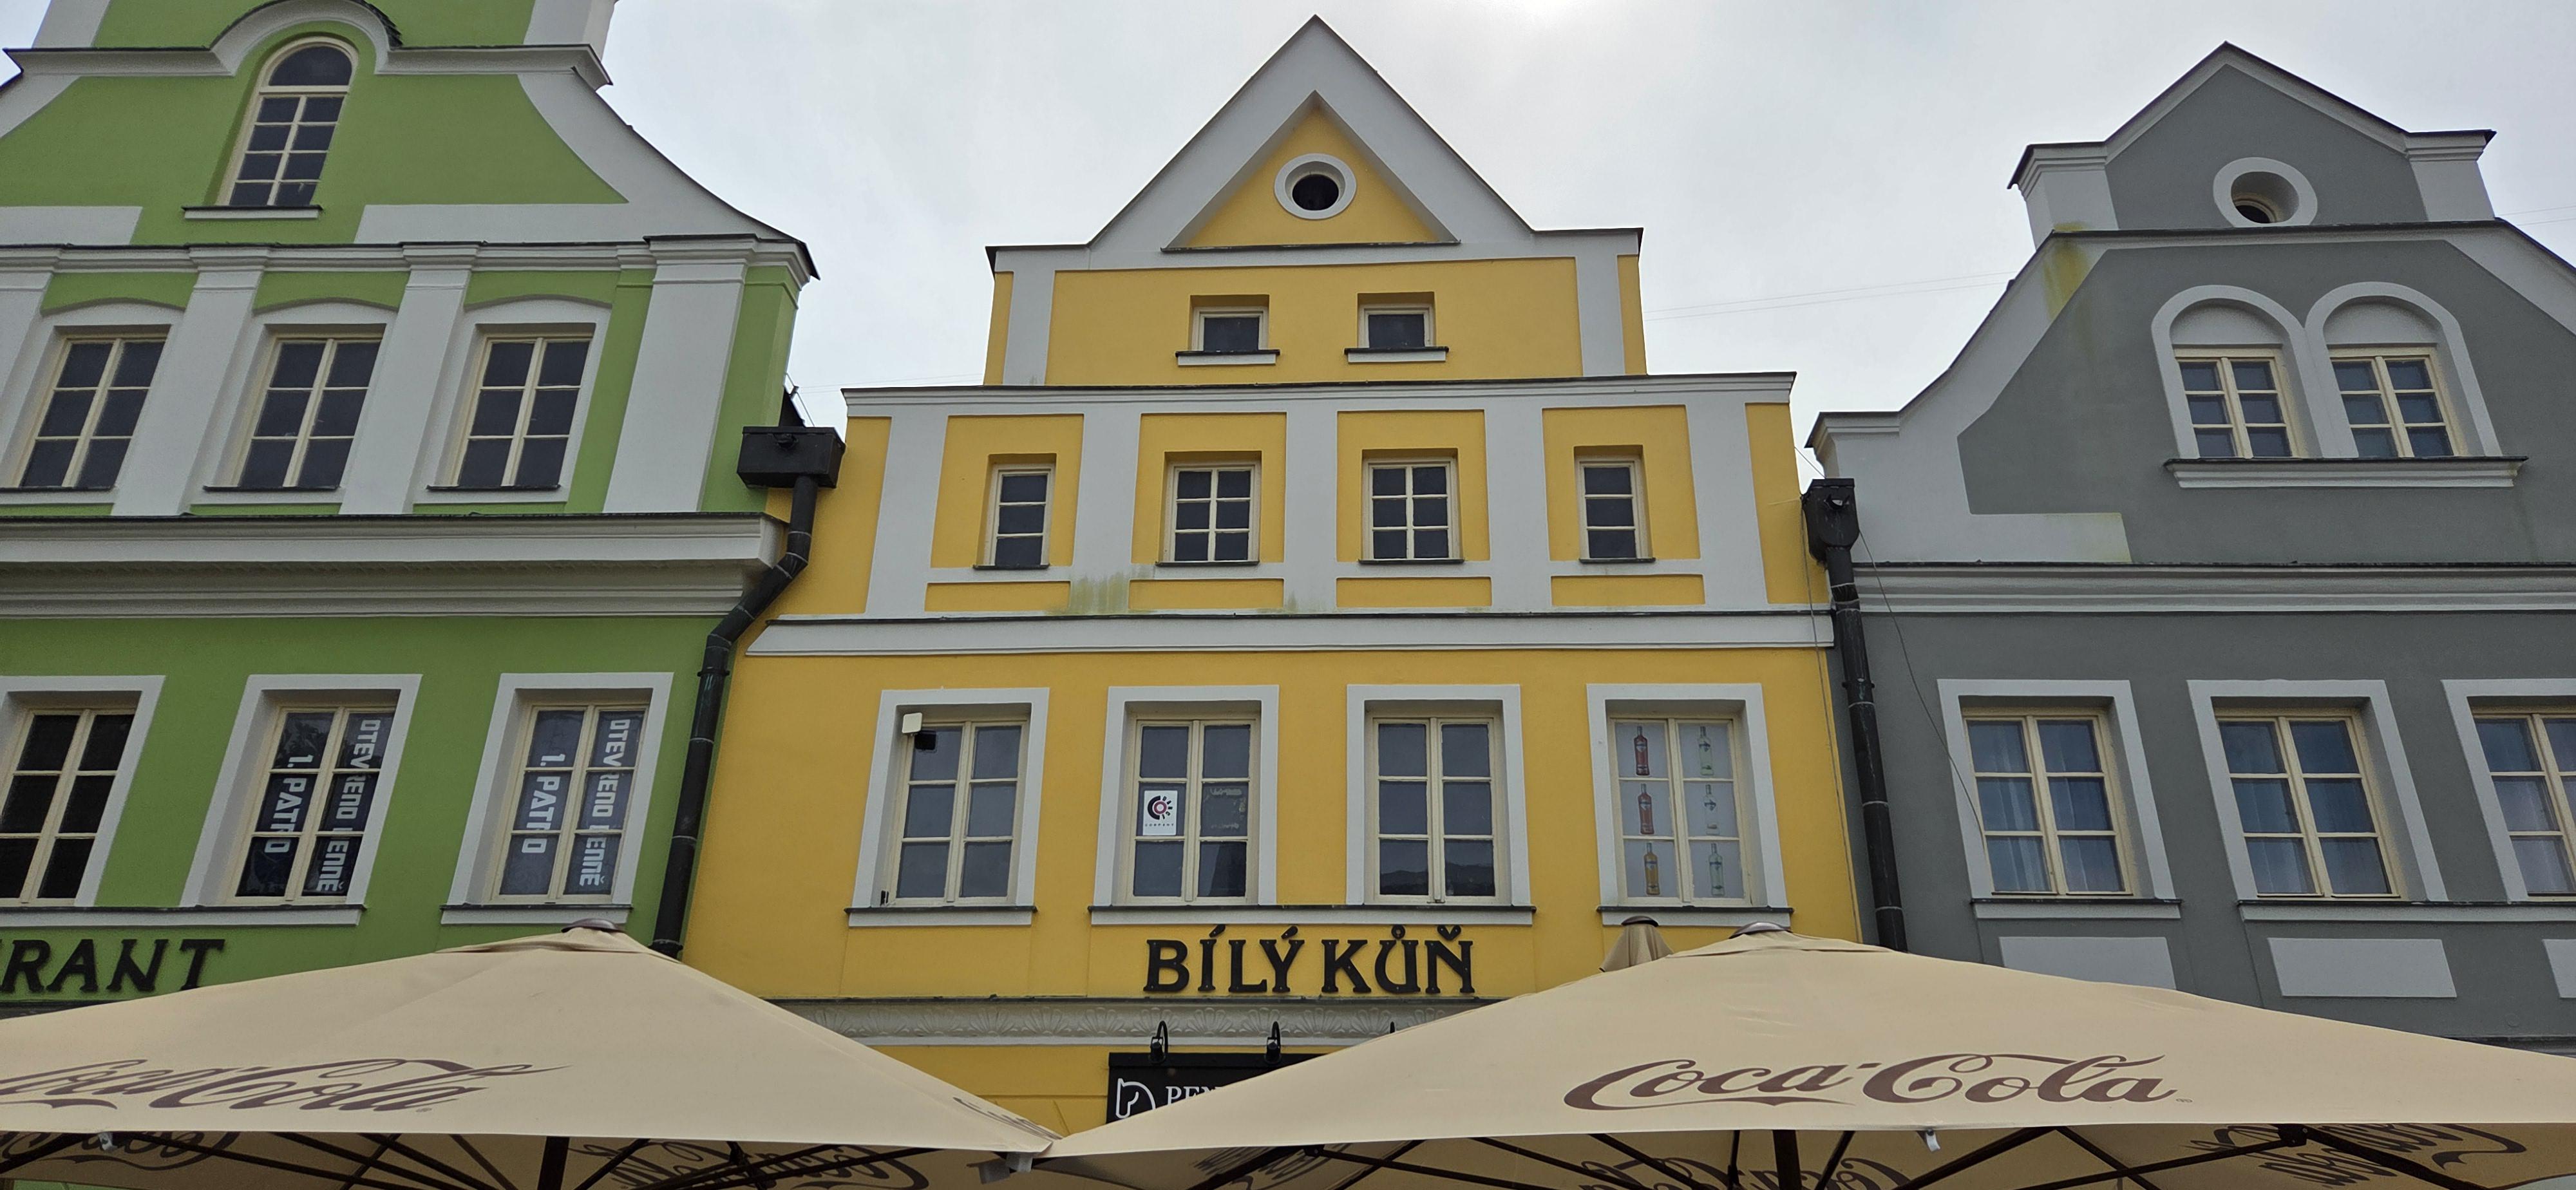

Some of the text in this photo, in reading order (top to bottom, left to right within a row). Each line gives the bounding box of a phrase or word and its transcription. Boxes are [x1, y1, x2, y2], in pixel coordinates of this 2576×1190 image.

[287, 754, 314, 768] 1.
[540, 753, 565, 766] 1.
[0, 939, 225, 992] RANT
[1143, 924, 1475, 994] BÍLÝ KŮŇ
[1563, 1053, 2178, 1111] Coca-Cola
